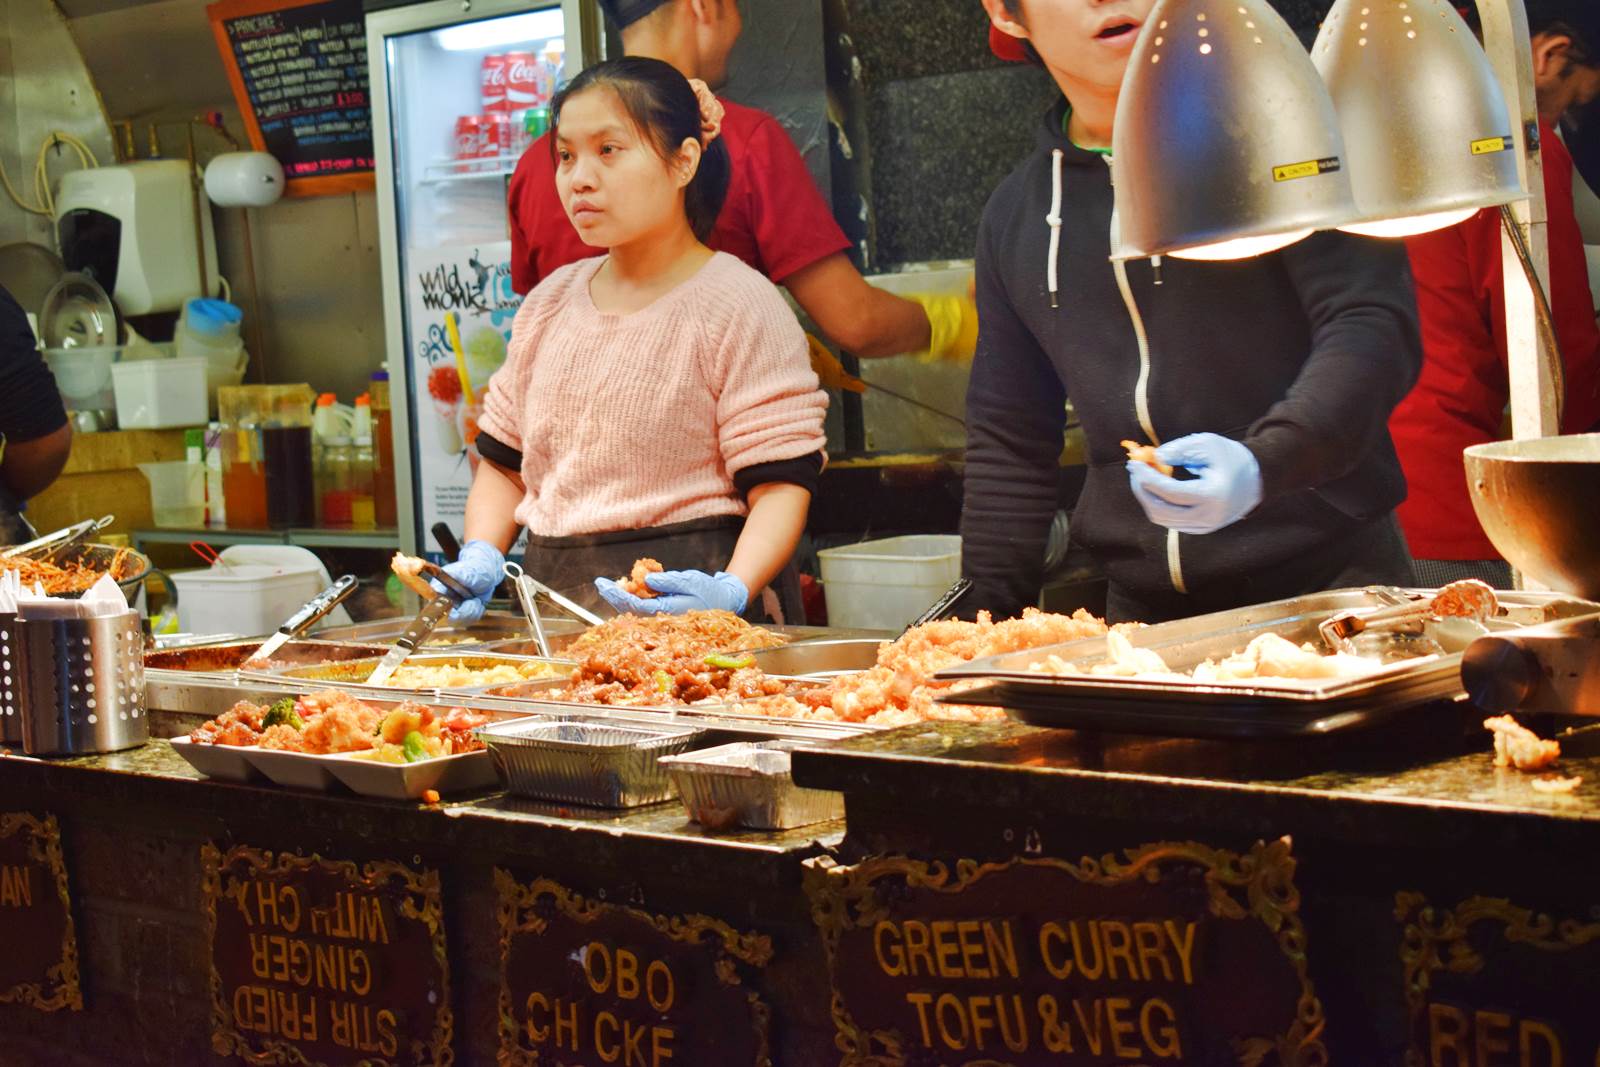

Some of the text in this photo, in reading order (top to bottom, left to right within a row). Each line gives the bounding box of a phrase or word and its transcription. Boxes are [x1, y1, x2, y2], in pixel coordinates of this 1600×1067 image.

[250, 932, 372, 996] GINGER
[874, 919, 1196, 985] GREEN CURRY
[234, 984, 398, 1058] STIR FRIED
[906, 993, 1028, 1052] TOFU
